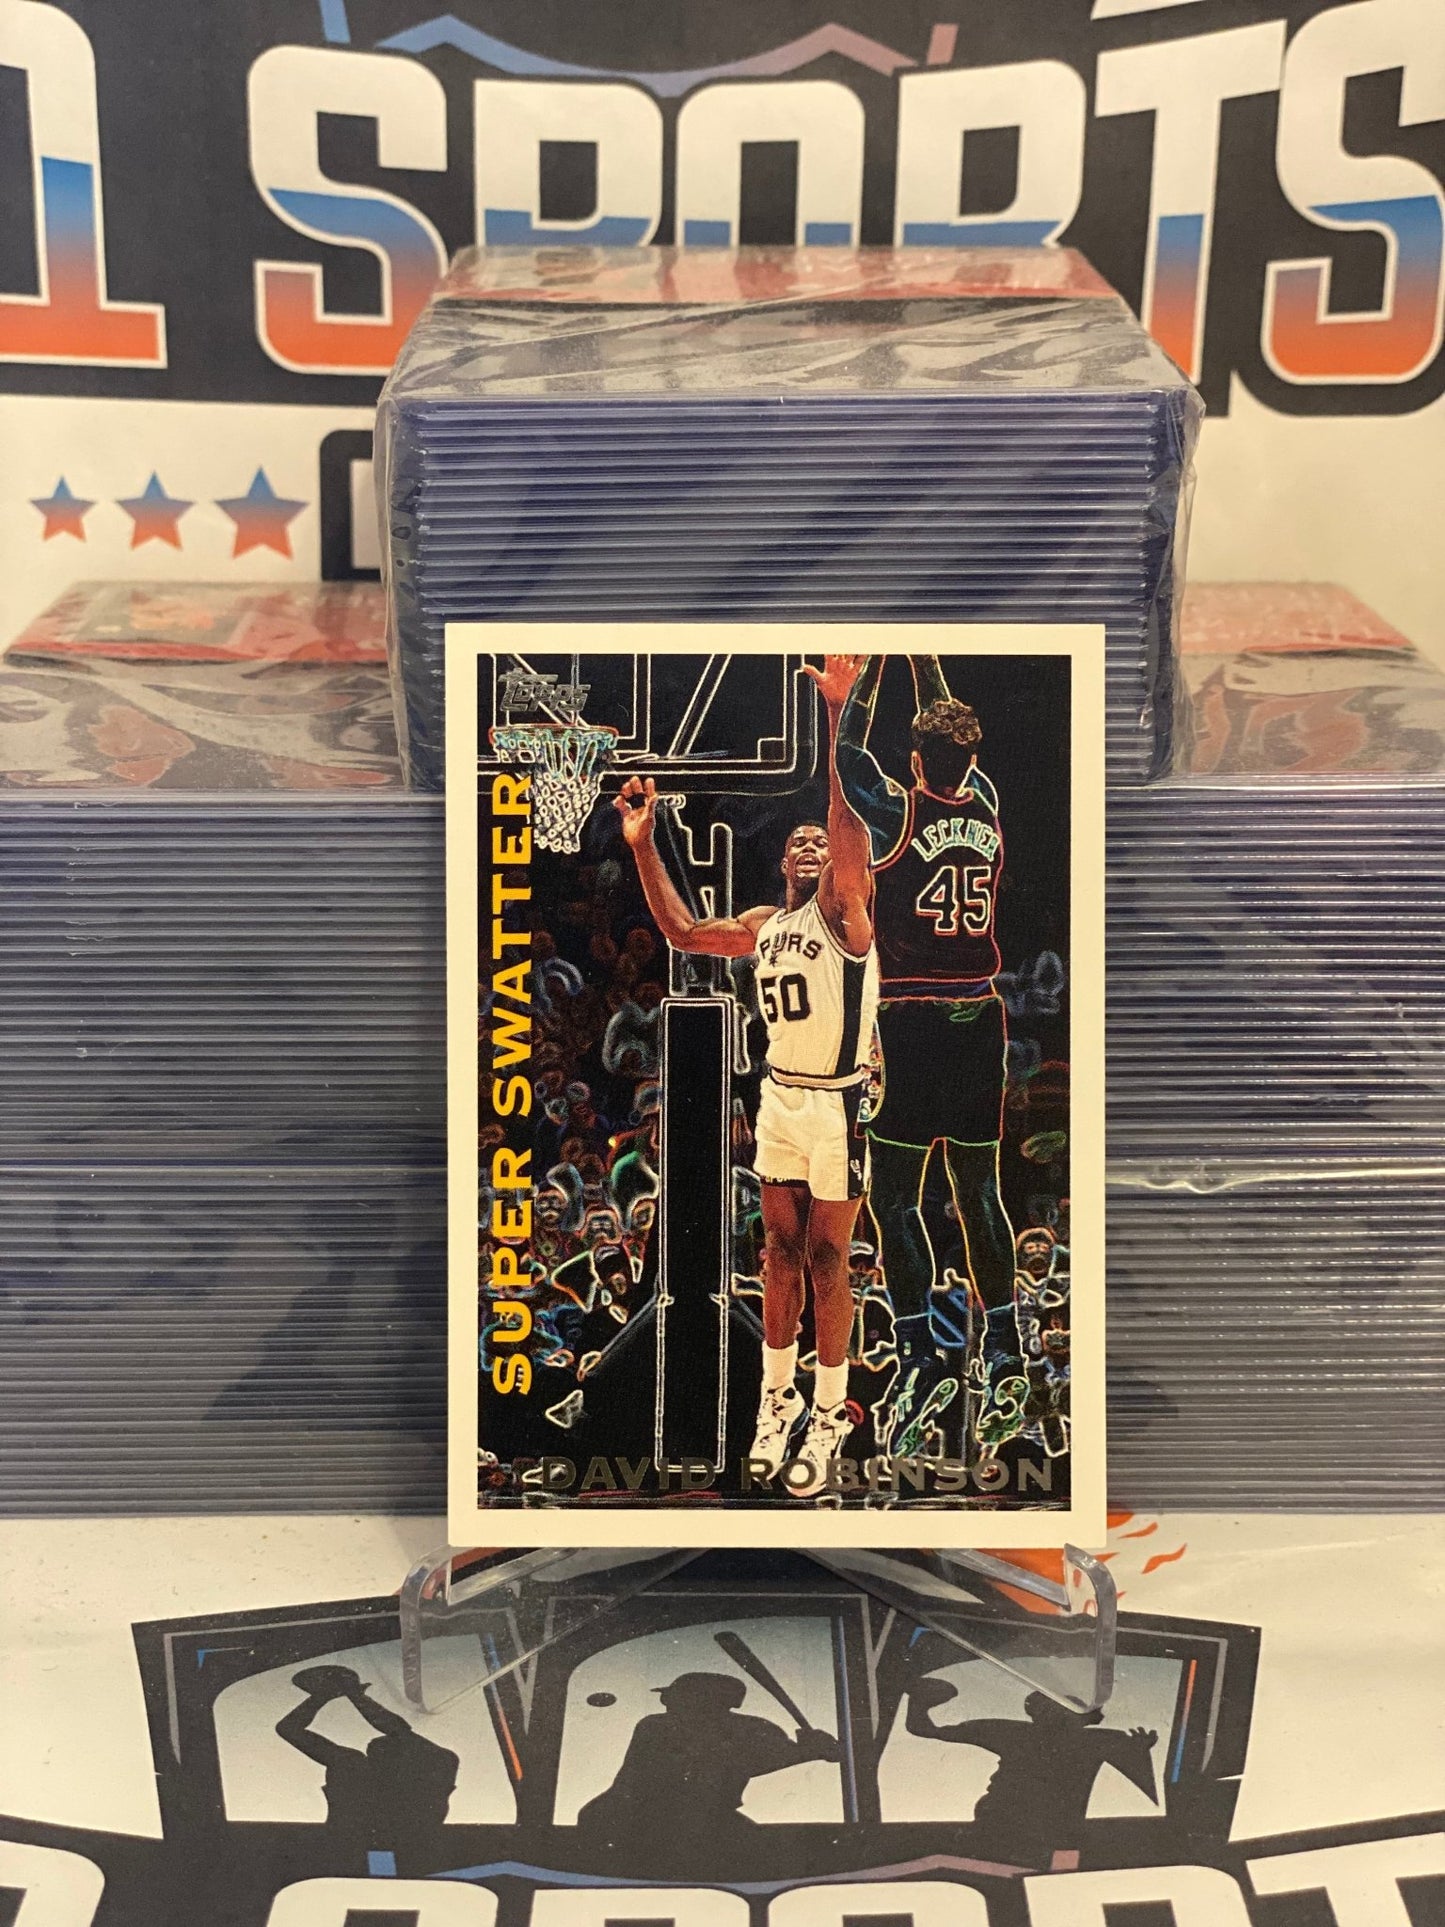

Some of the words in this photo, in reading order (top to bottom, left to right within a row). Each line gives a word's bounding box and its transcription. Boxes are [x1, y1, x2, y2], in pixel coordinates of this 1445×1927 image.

[247, 0, 1445, 385] SPORTS
[911, 817, 1000, 862] LECKNER
[916, 866, 992, 936] 45
[492, 773, 532, 1117] SWATTER
[759, 931, 823, 963] PURS
[760, 973, 811, 1023] 50
[492, 1148, 532, 1395] SUPER
[542, 1456, 716, 1492] DAVID
[743, 1456, 1053, 1492] ROBINSON
